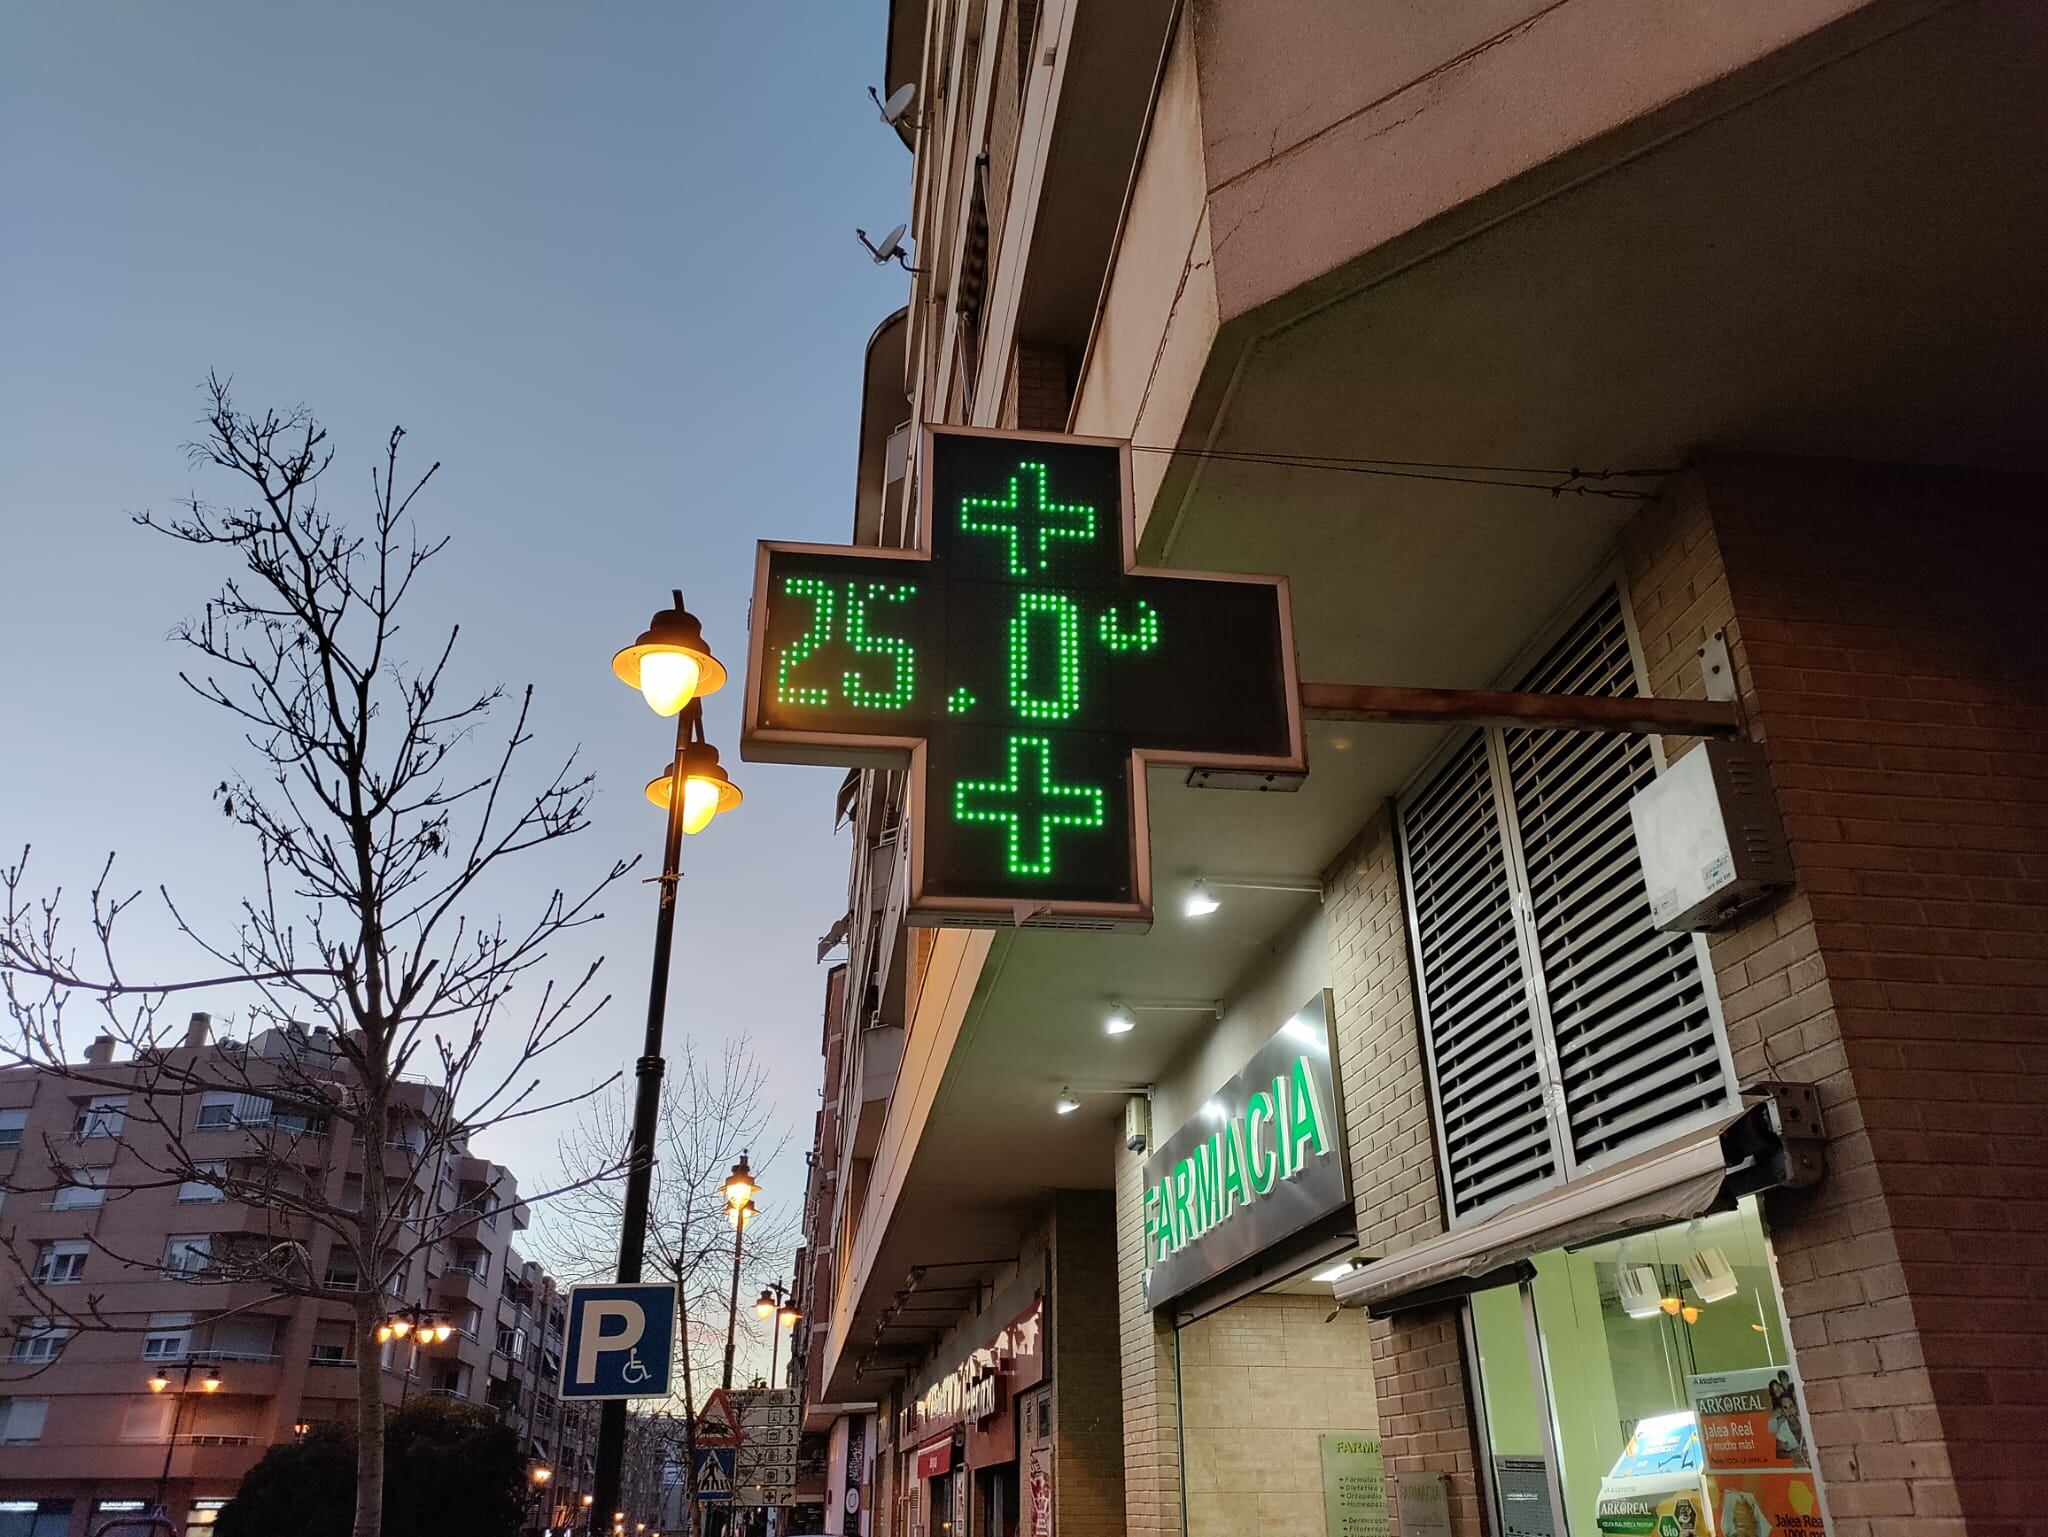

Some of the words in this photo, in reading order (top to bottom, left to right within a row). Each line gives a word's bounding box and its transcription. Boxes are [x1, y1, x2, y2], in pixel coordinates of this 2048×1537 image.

[1144, 1056, 1335, 1269] FARMACIA
[576, 1299, 646, 1384] P
[1699, 1394, 1767, 1414] ARKOREAL
[1704, 1422, 1729, 1440] Jalea
[1731, 1421, 1754, 1437] Real
[1714, 1441, 1737, 1452] mucho
[1600, 1502, 1652, 1515] ARKOREAL
[1775, 1513, 1800, 1528] Jalea
[1662, 1525, 1679, 1537] Bio
